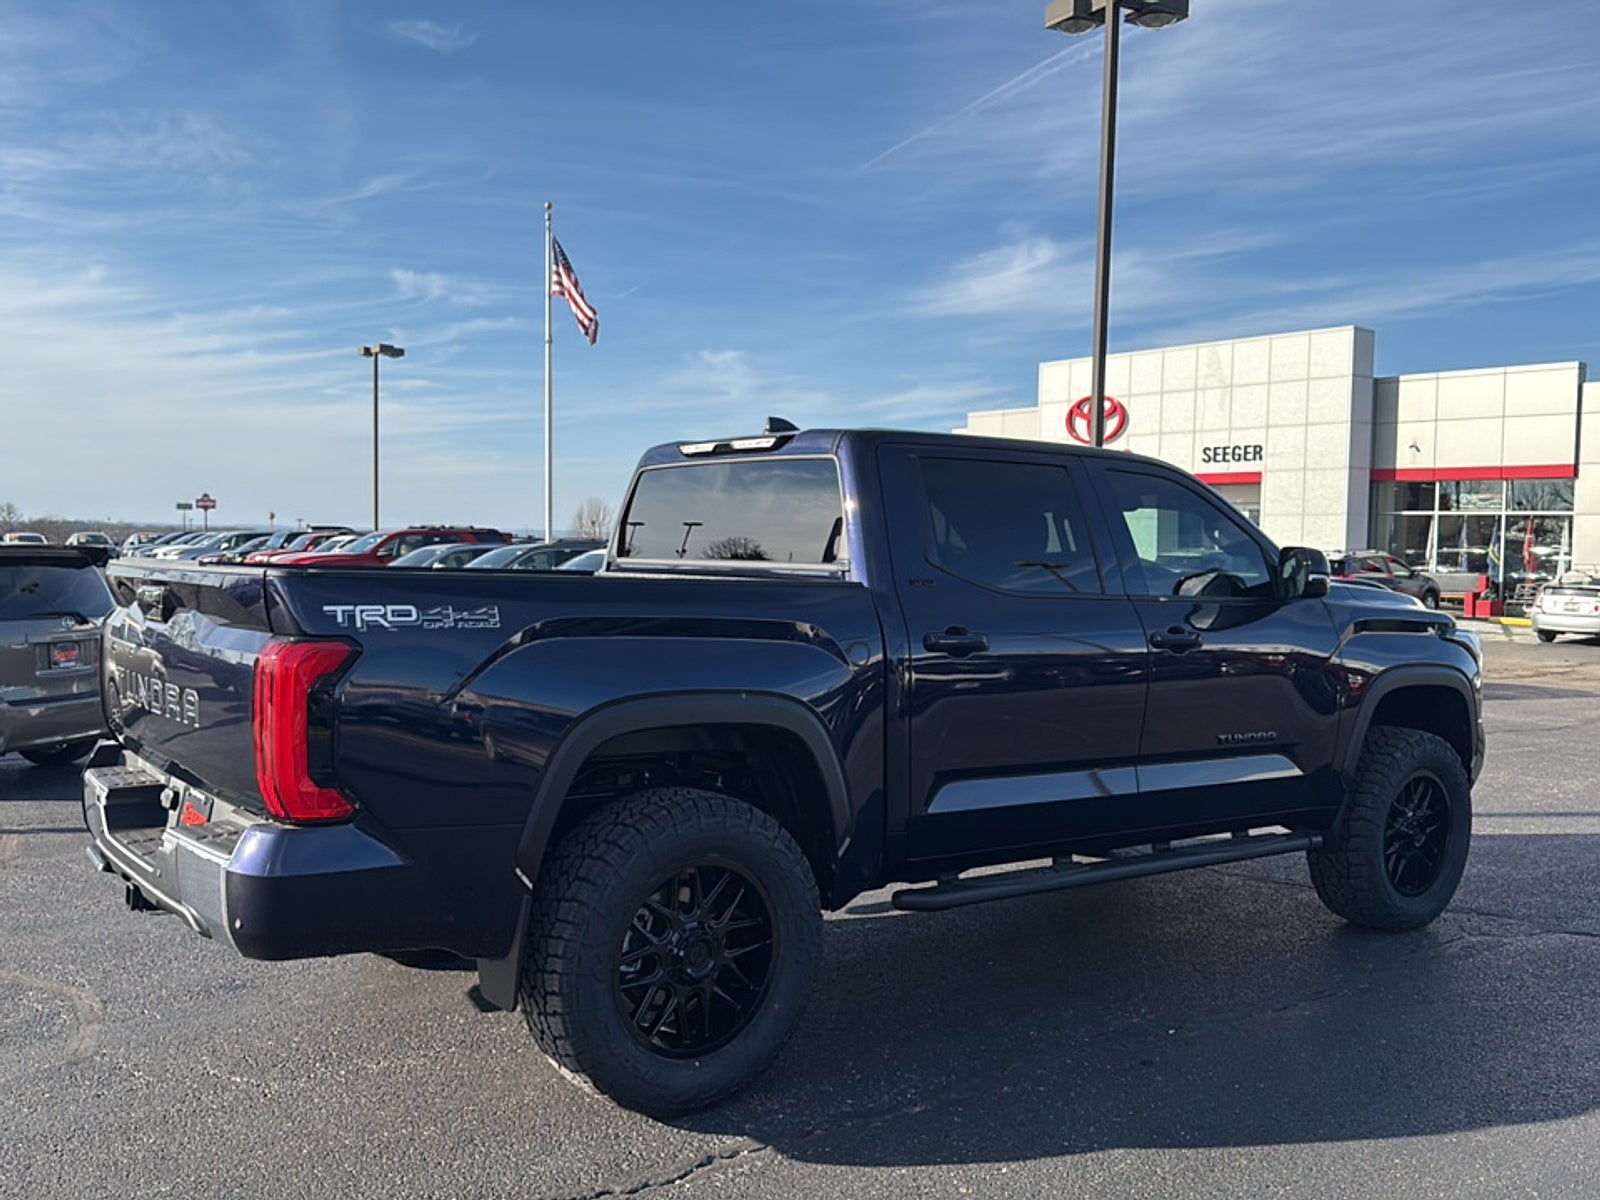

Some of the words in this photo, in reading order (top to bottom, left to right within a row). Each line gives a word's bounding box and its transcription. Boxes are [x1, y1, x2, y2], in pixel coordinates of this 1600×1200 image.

[1202, 445, 1263, 463] SEEGER
[322, 605, 418, 631] TRD
[114, 665, 200, 728] TUNDRA
